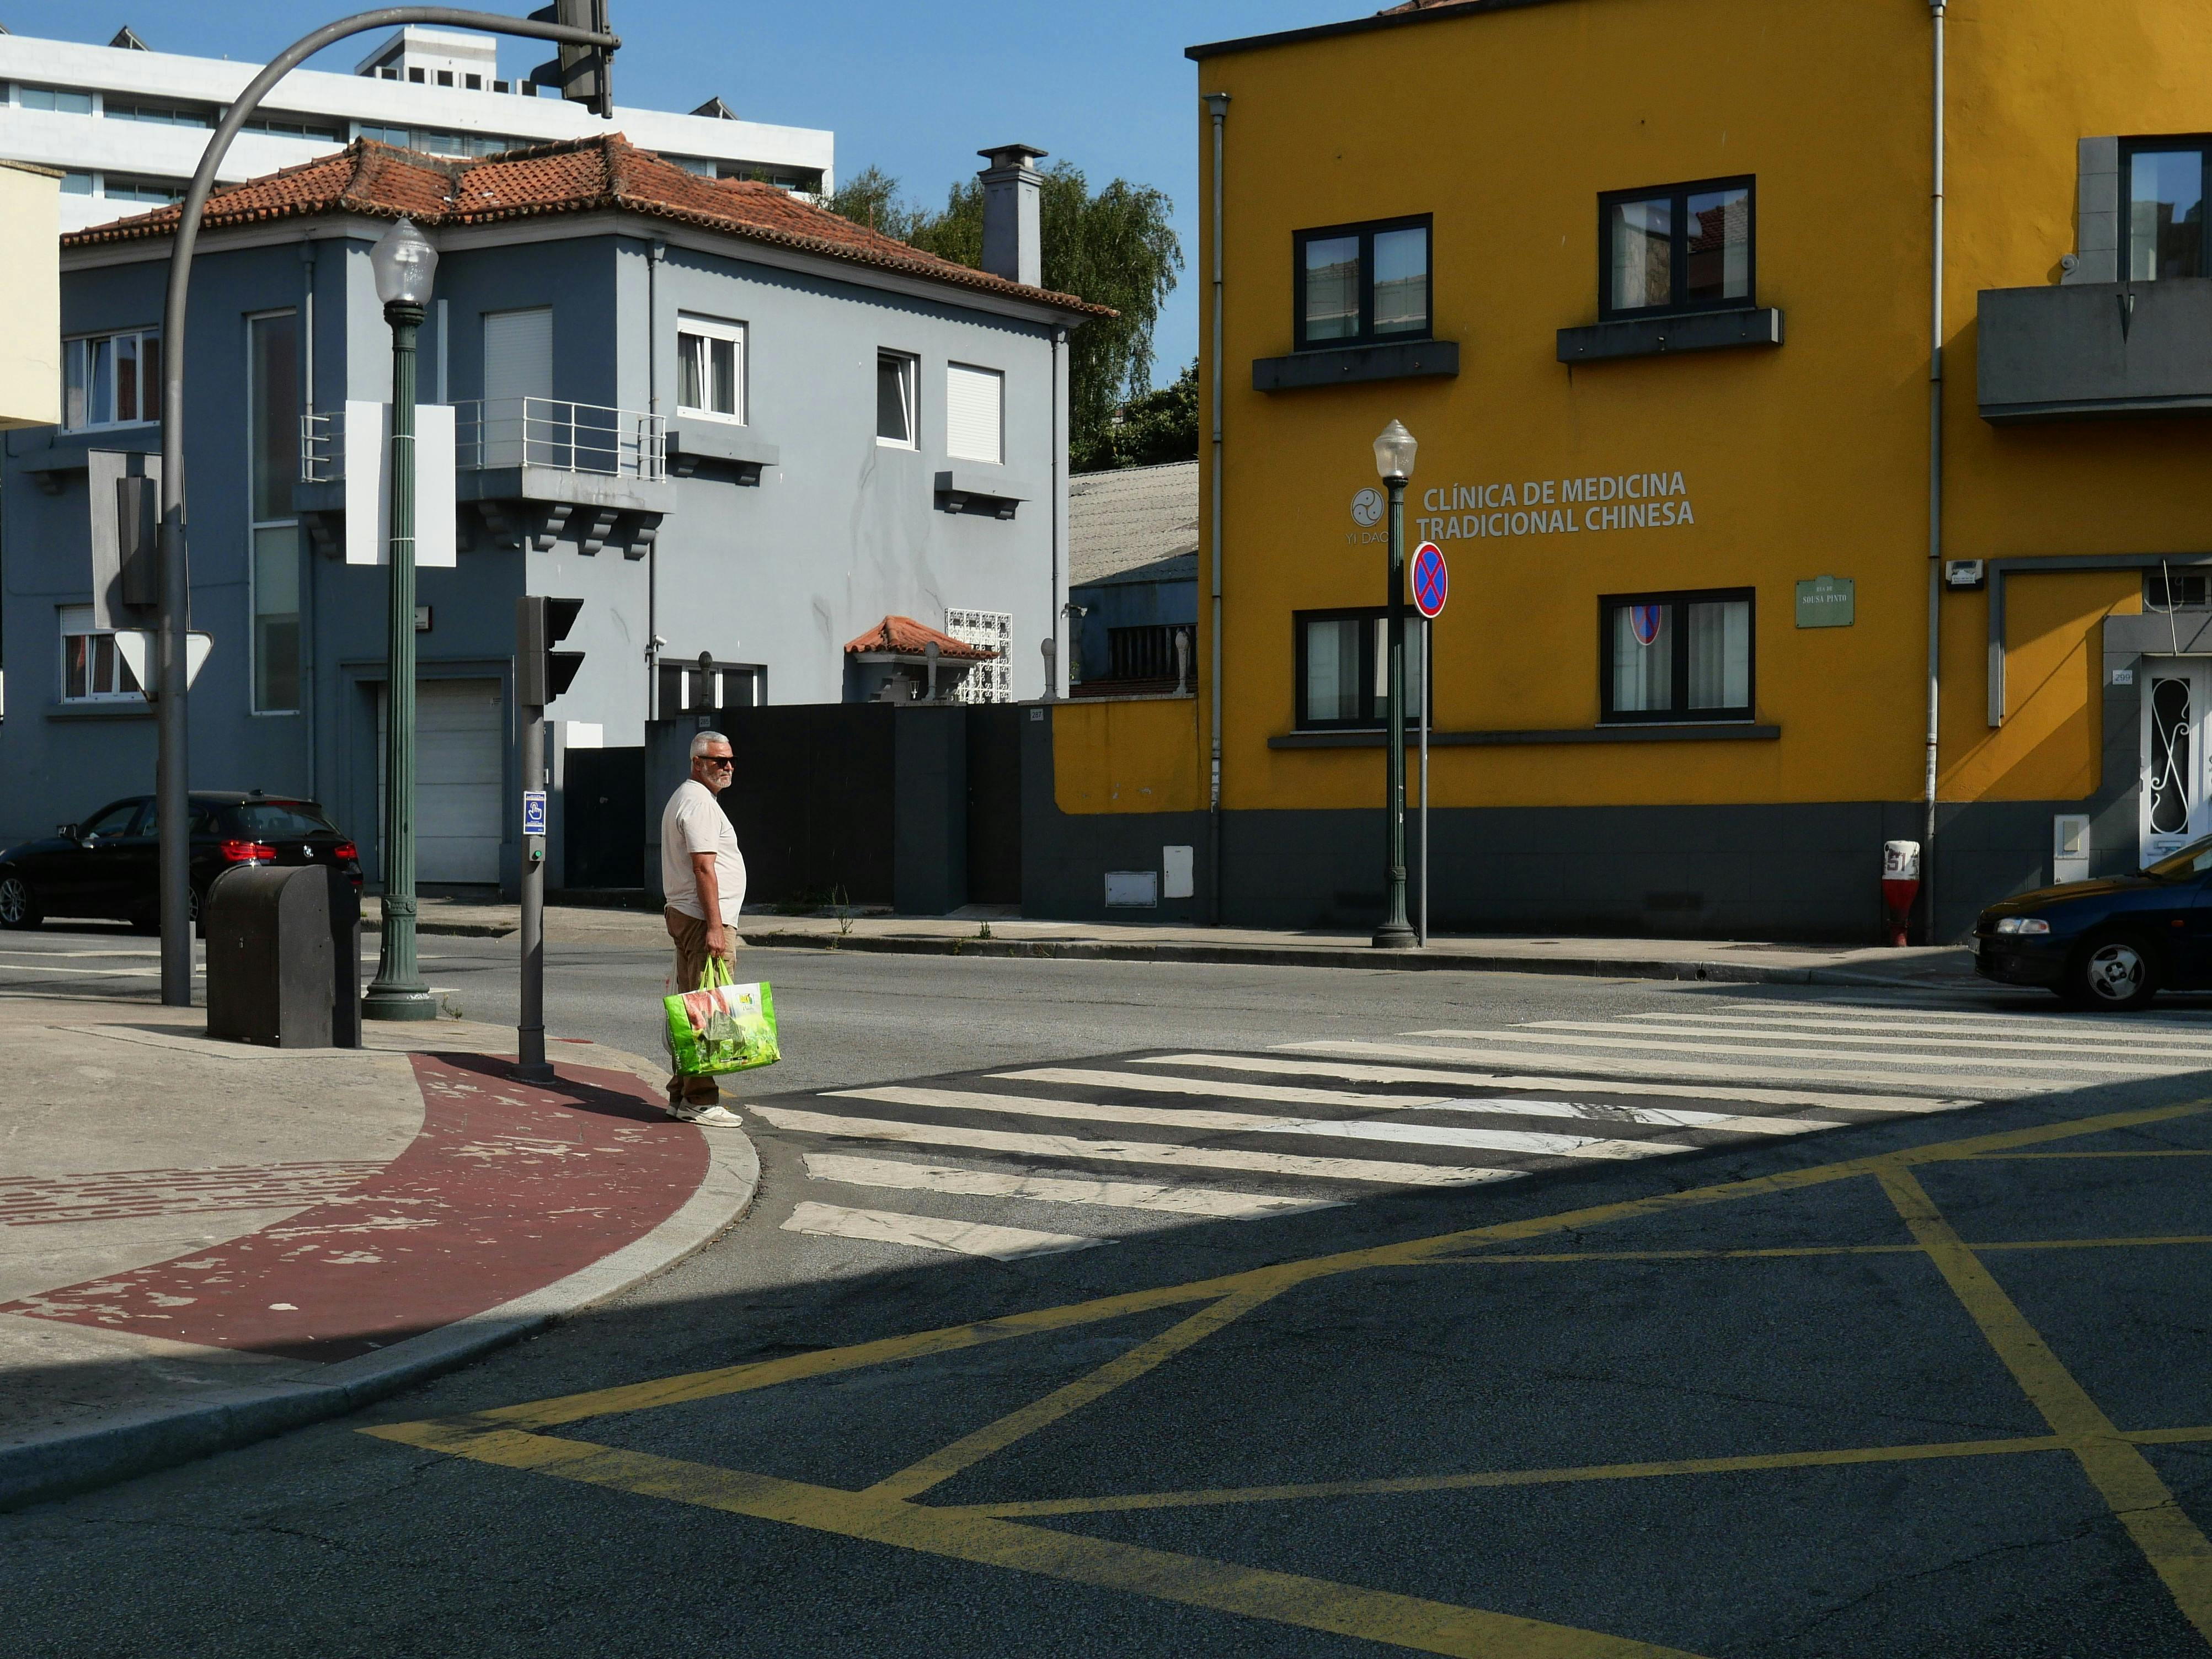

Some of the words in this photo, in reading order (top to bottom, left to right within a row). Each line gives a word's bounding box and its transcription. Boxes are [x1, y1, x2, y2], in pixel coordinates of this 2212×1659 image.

[1424, 483, 1516, 512] CLÍNICA
[1524, 481, 1555, 506] DE
[1562, 471, 1686, 503] MEDICINA
[1416, 509, 1579, 541] TRADICIONAL
[1585, 500, 1694, 531] CHINESA
[1346, 533, 1356, 545] YI
[1803, 595, 1824, 604] SOUSA
[1827, 594, 1846, 602] PINTO
